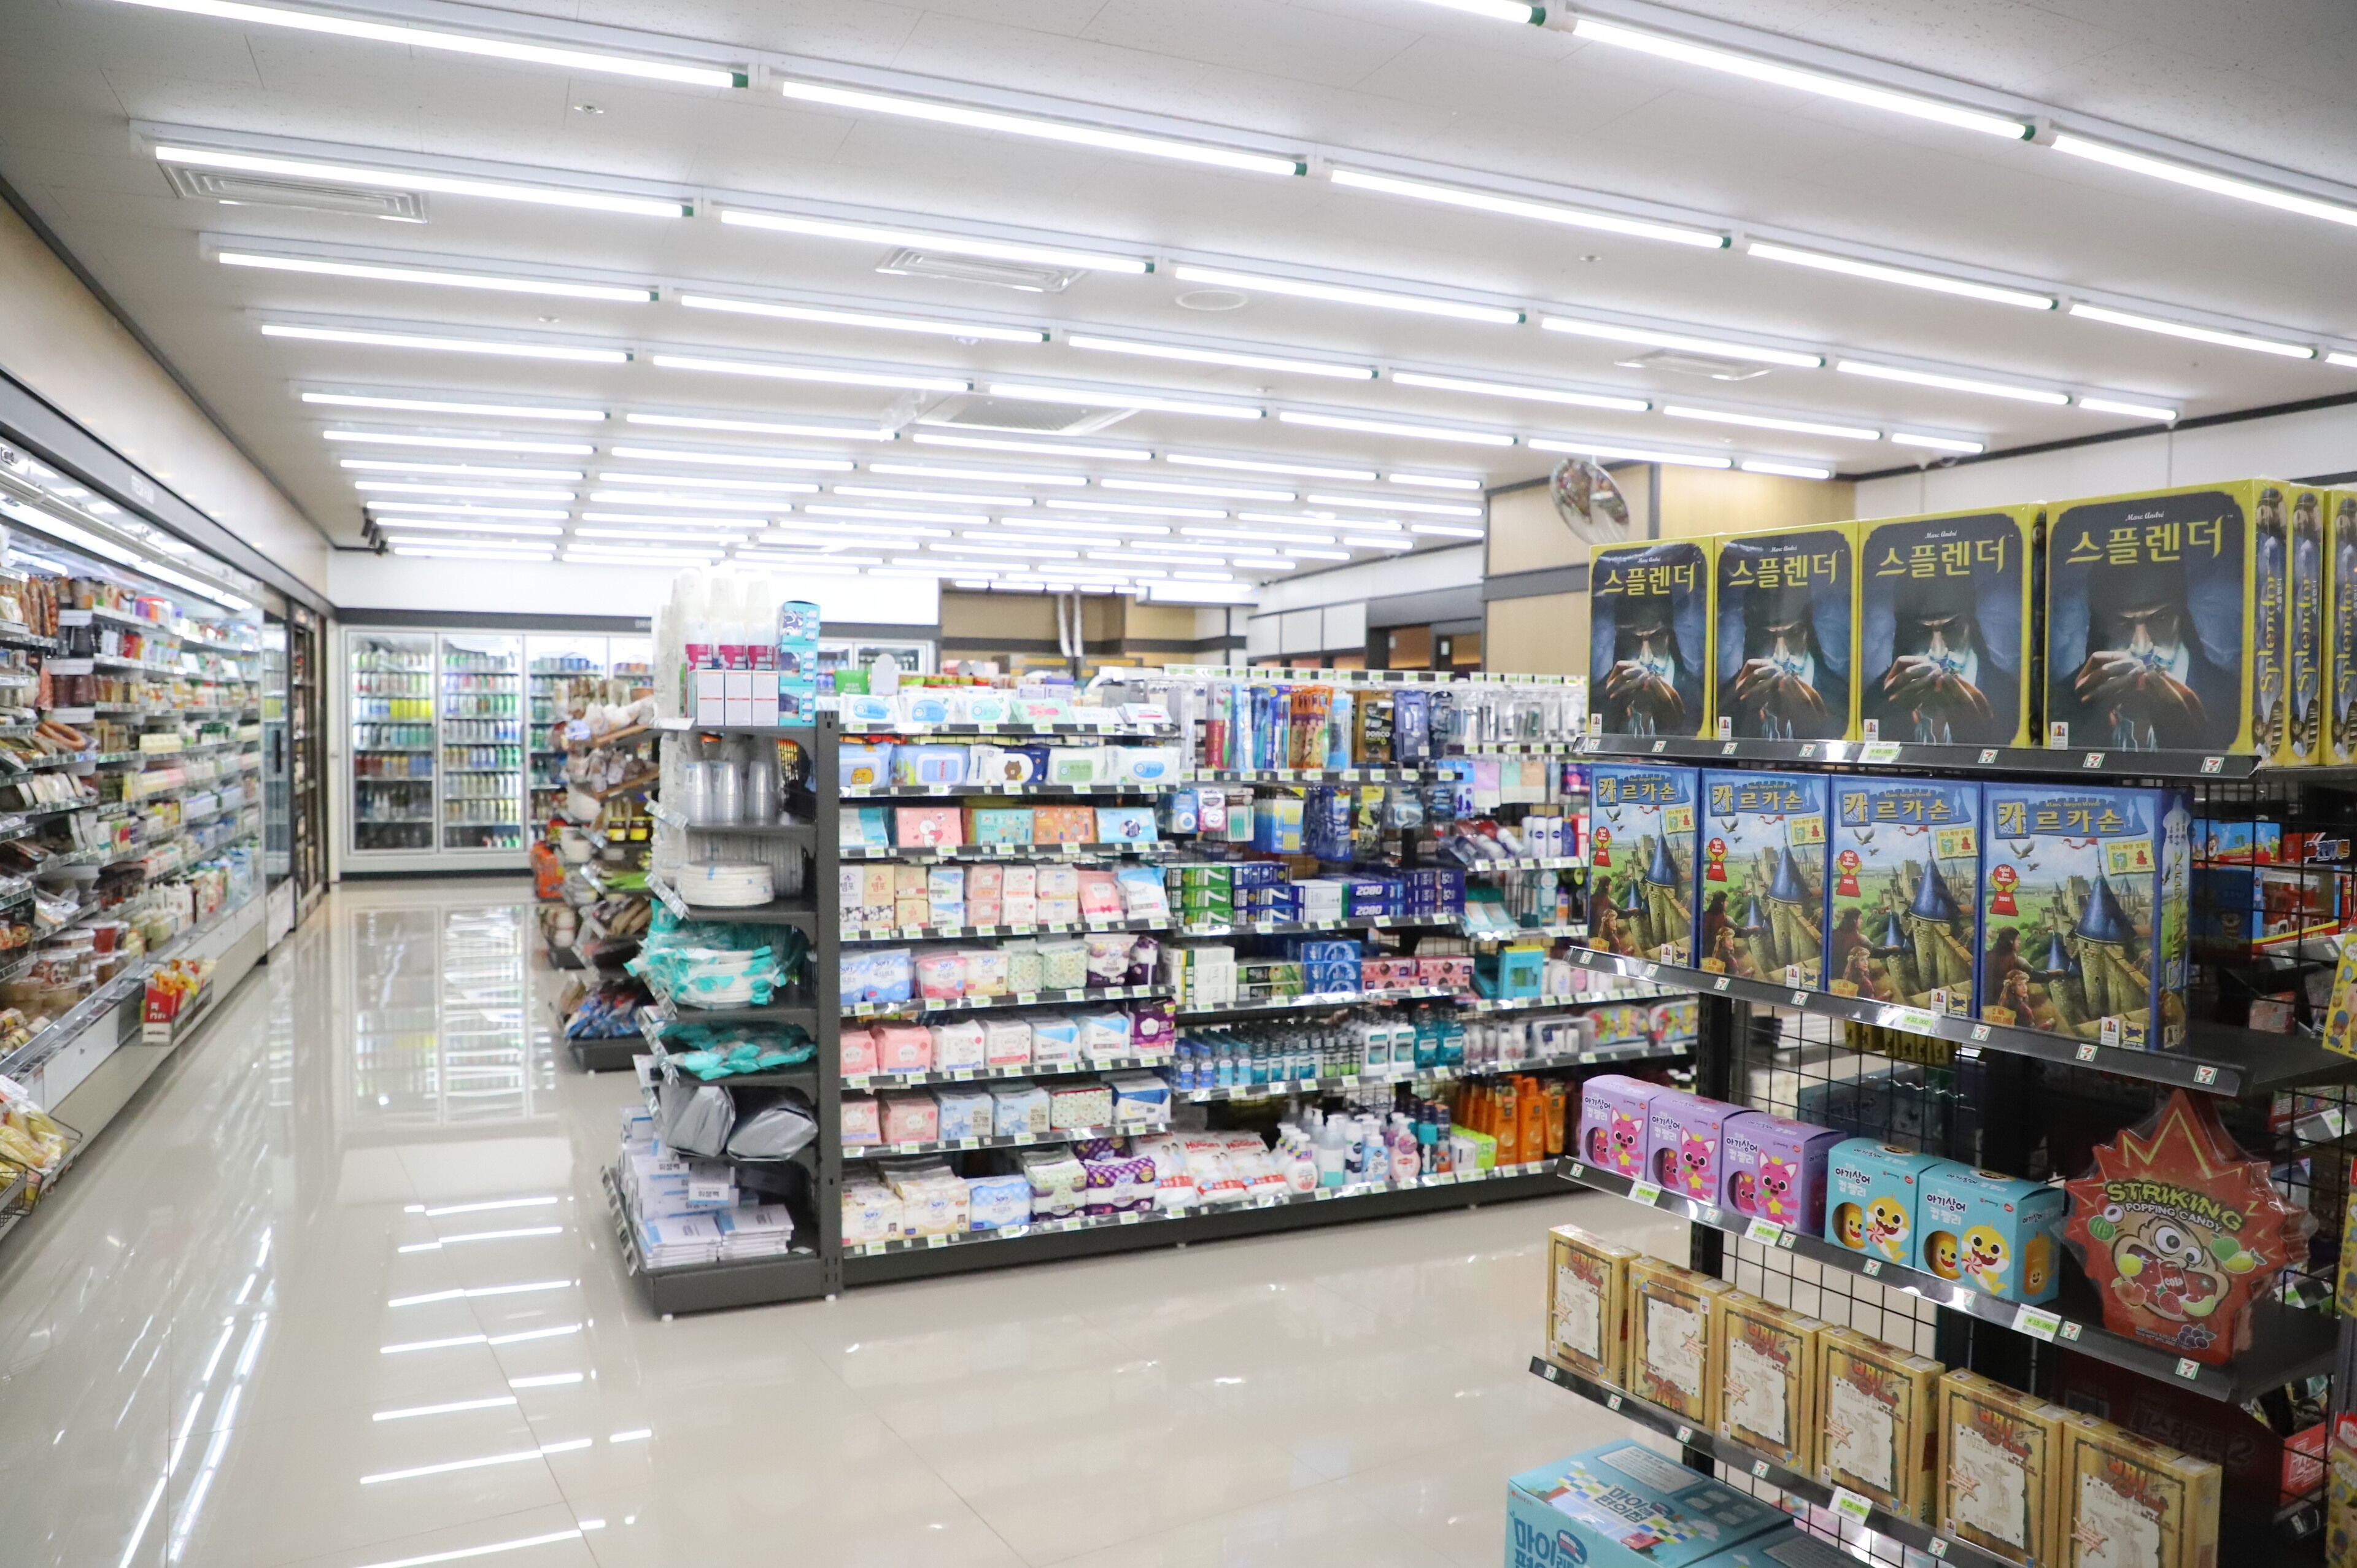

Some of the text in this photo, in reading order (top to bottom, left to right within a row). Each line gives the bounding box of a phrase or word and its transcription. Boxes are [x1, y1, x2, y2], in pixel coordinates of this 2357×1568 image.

[2065, 514, 2224, 565] 스플렌더
[1728, 550, 1838, 588] 스플렌더
[1876, 535, 2007, 577] 스플렌더
[1601, 561, 1696, 596] 스플렌더
[2258, 570, 2281, 692] Splendor
[2294, 572, 2316, 692] Splendor
[1598, 777, 1676, 803] 카르카손
[1713, 785, 1803, 813] 카르카손
[1843, 793, 1951, 822] 카르카손
[1998, 801, 2124, 835] 카르카손
[1356, 885, 1384, 897] 2080
[1355, 905, 1383, 916] 2080
[1726, 1137, 1758, 1153] 아기상어
[1835, 1167, 1870, 1184] 아기상어
[1927, 1193, 1966, 1213] 아기상어
[2106, 1180, 2244, 1231] STRIKING
[2126, 1203, 2223, 1232] POPPING CANDY
[1594, 1494, 1648, 1523] 편의점
[1608, 1487, 1648, 1509] 마이
[1514, 1517, 1557, 1566] 마이
